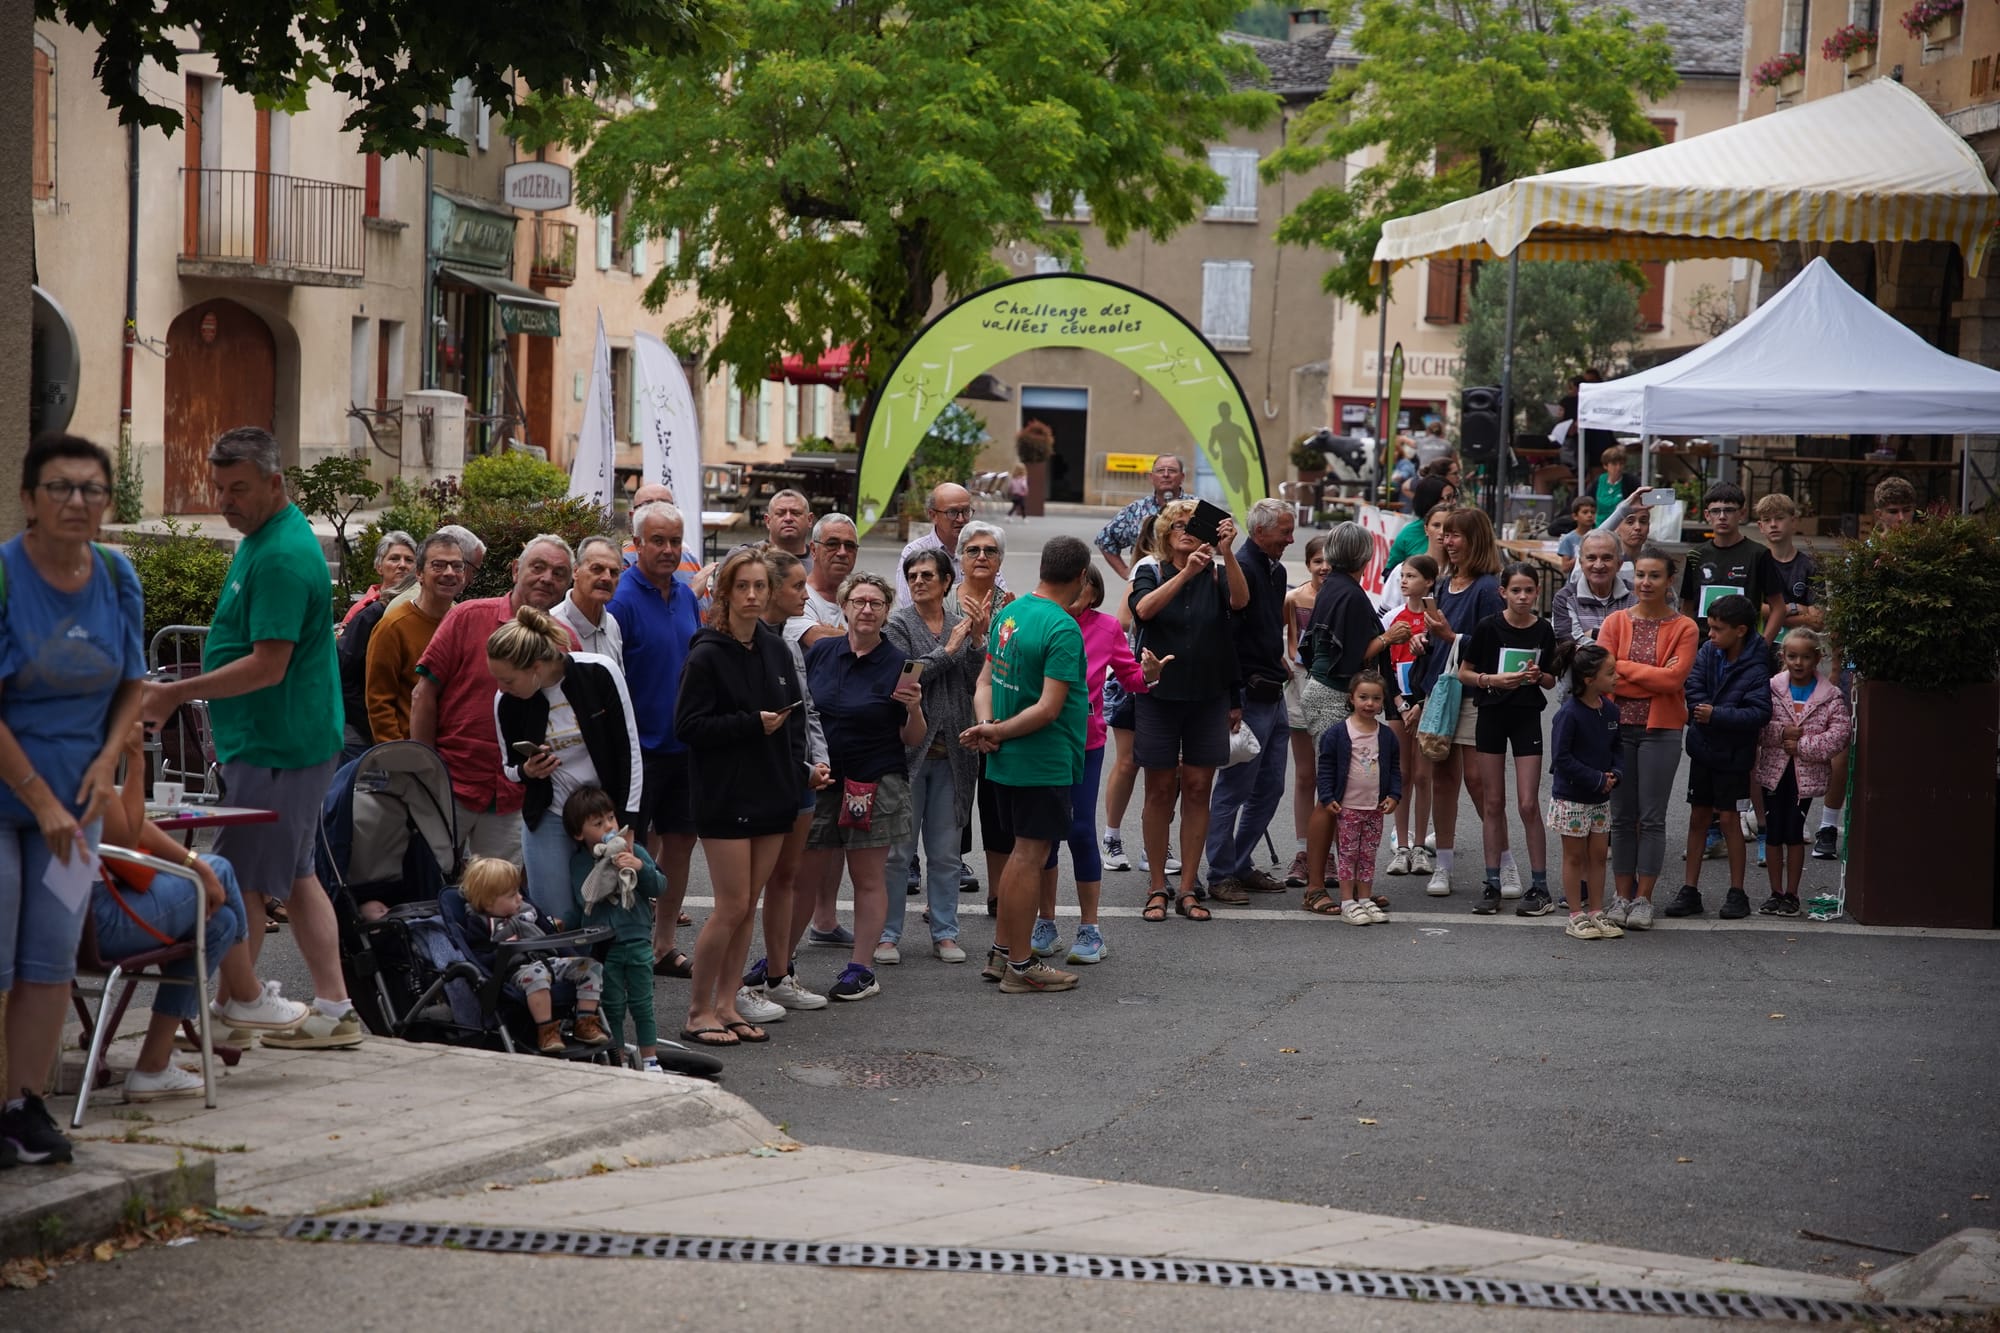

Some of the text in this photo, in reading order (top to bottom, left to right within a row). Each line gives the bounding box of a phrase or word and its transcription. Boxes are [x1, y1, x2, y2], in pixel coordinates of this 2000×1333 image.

[512, 174, 563, 199] PIZZERIA
[994, 301, 1131, 322] Challenge des
[982, 319, 1142, 335] vallées cévenoles
